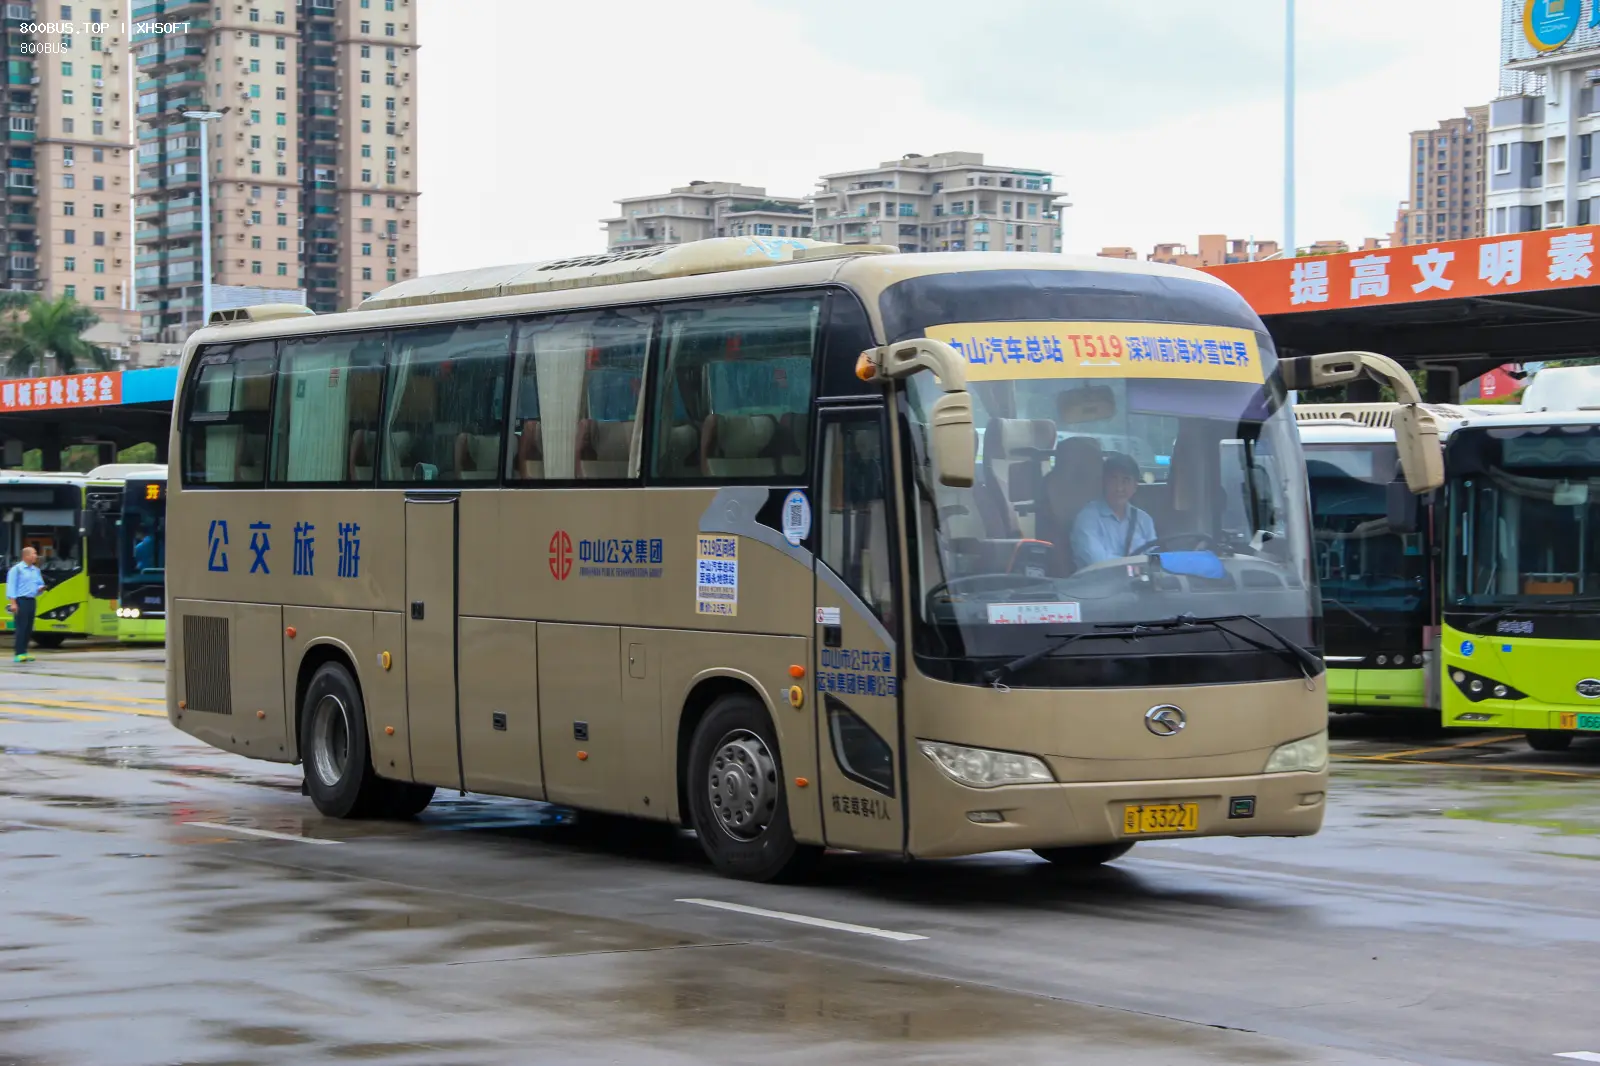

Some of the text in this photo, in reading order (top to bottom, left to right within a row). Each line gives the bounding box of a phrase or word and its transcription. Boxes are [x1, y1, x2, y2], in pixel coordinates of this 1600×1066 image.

[1290, 233, 1593, 305] 提高文明素
[948, 334, 1249, 367] 中山汽车总站 T519 深圳前海冰雪世界
[207, 519, 361, 578] 公交旅游
[579, 538, 663, 563] 中山公交集团
[821, 648, 891, 672] 中山市公共交通
[816, 671, 897, 697] 运输集团有限公司
